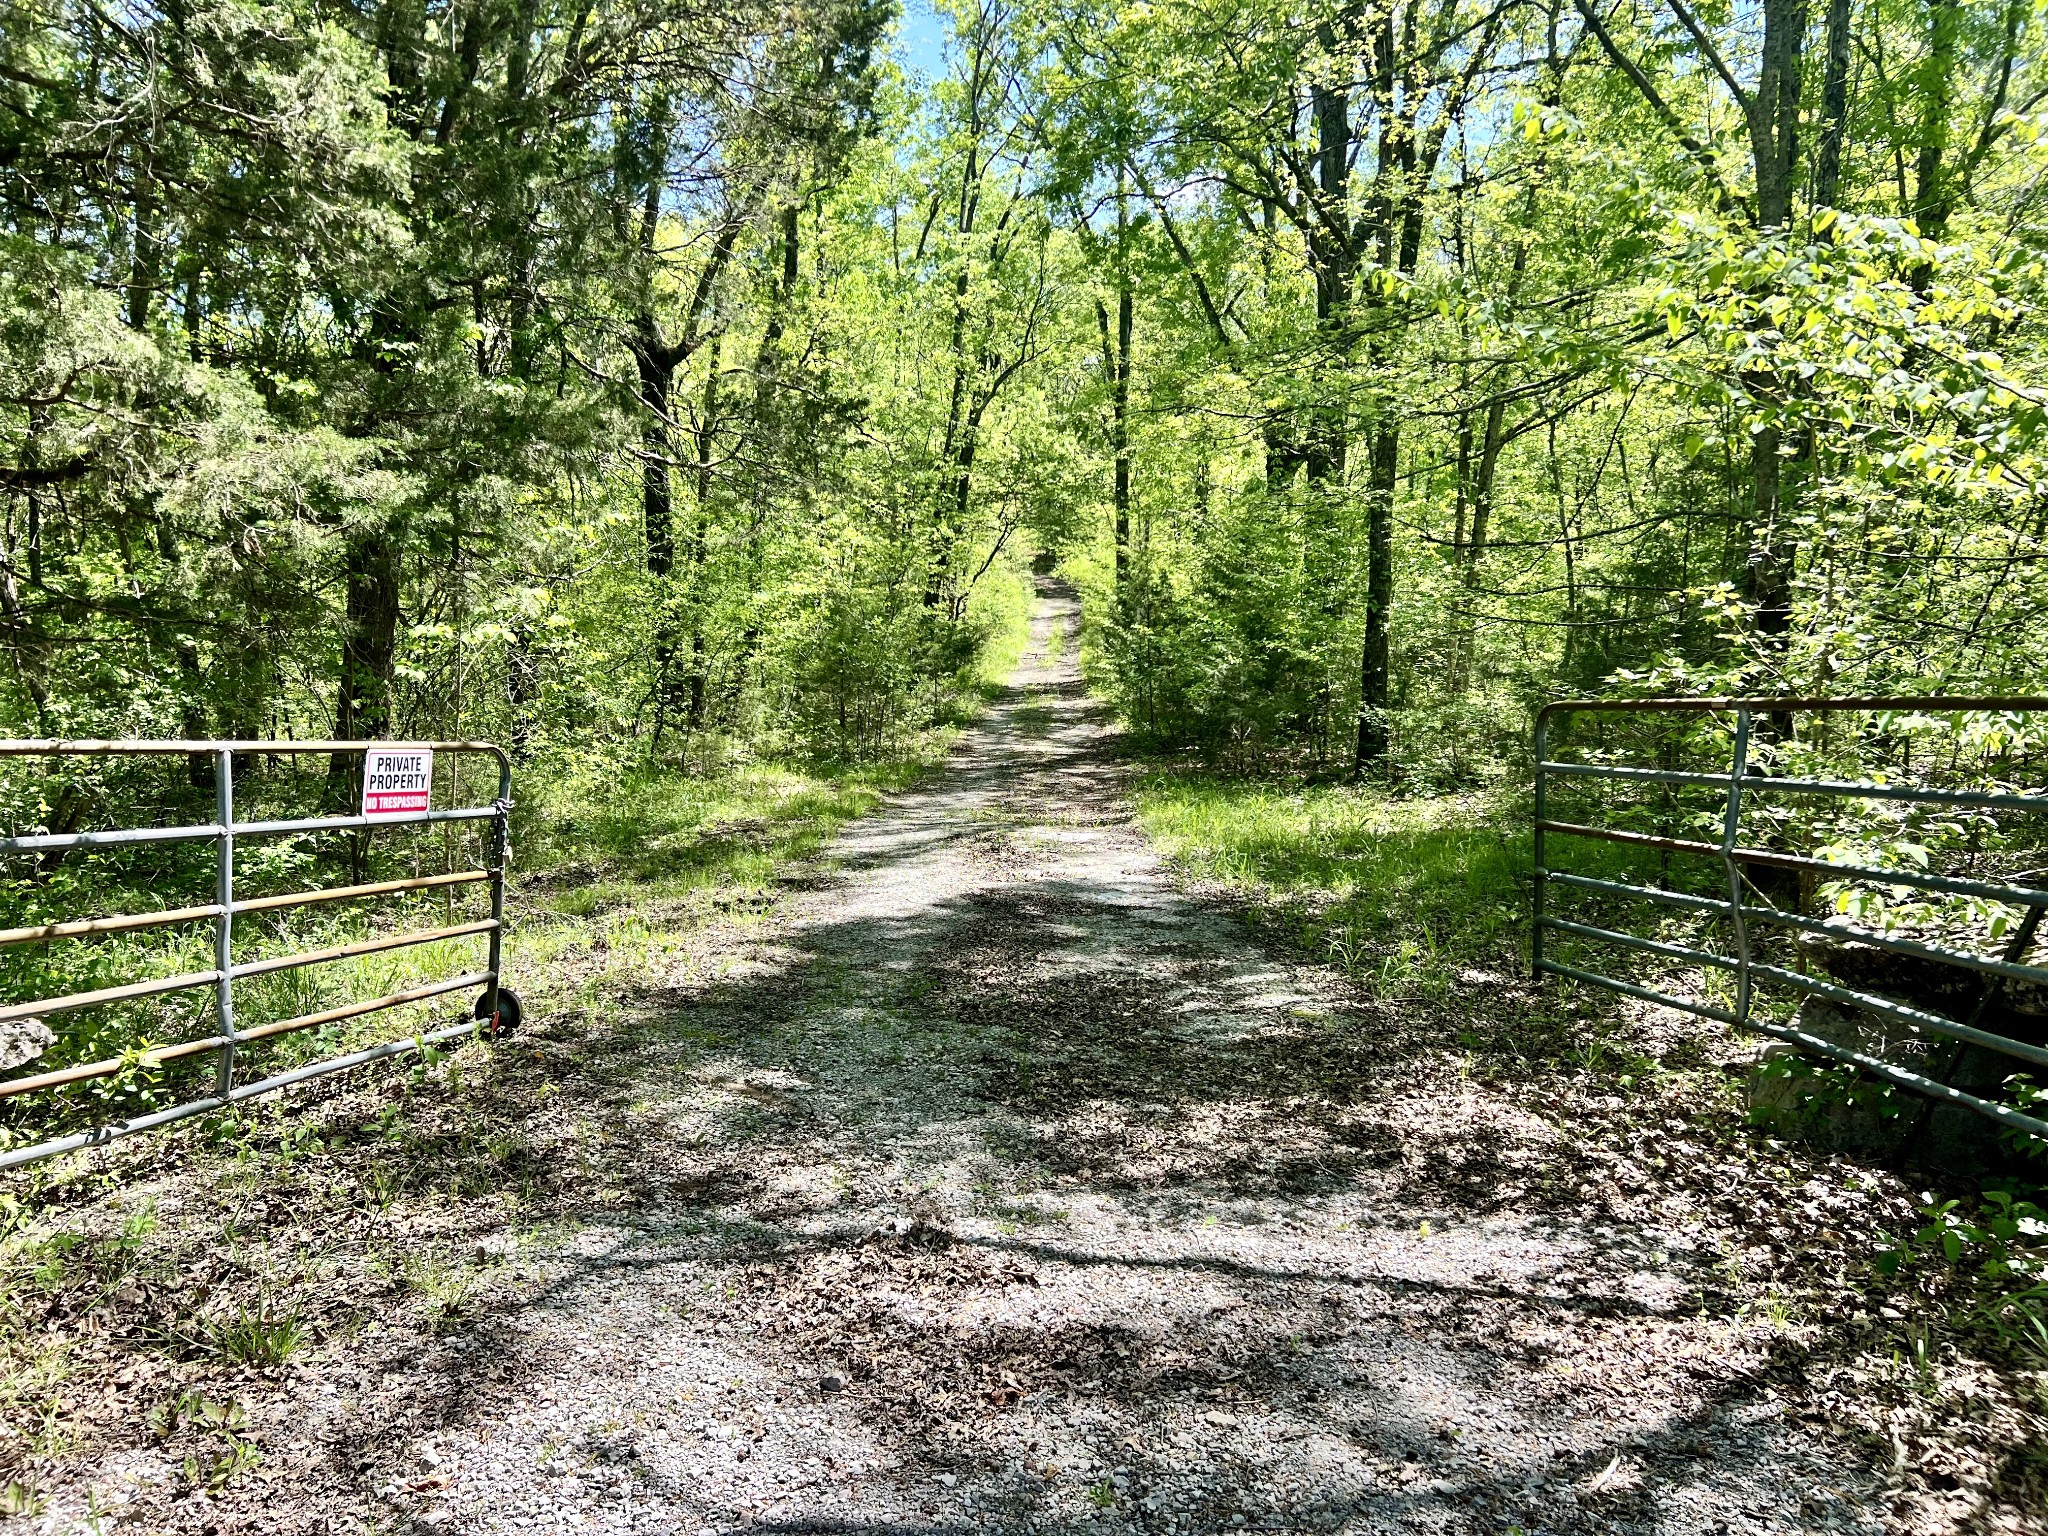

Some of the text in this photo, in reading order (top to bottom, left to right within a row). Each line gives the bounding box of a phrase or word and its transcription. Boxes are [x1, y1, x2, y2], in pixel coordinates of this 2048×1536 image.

[377, 757, 422, 772] PRIVATE
[369, 774, 427, 790] PROPERTY
[366, 795, 427, 810] NO TRESPASSING
